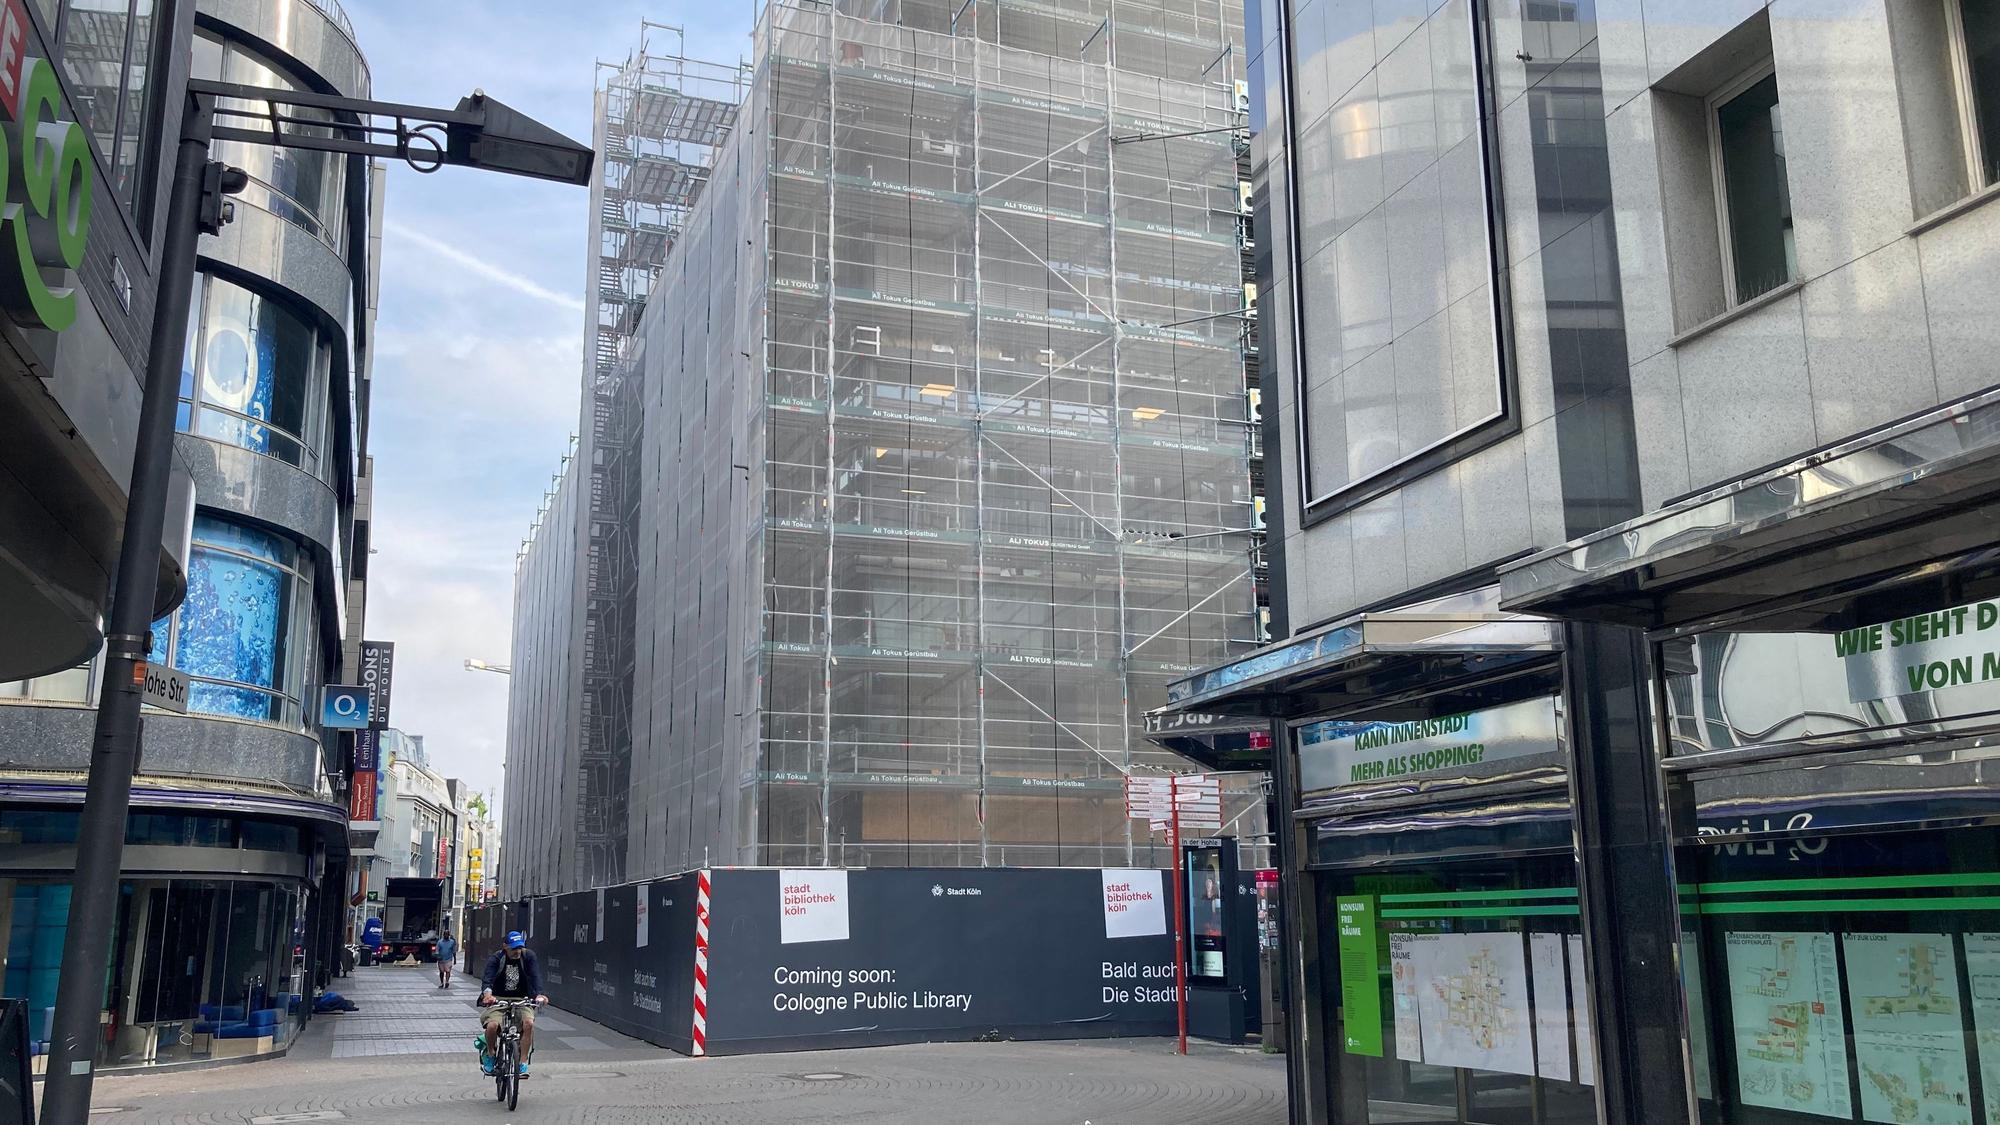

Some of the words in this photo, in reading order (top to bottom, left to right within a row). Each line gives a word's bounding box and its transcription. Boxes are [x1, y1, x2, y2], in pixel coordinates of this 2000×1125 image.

[798, 60, 818, 69] Tokus
[883, 75, 902, 84] Tokus
[1147, 122, 1170, 131] TOKUS
[23, 58, 92, 271] GO
[795, 167, 814, 176] Tokus
[882, 182, 901, 191] Tokus
[1018, 204, 1043, 213] TOKUS
[791, 281, 819, 290] TOKUS
[882, 294, 902, 302] Tokus
[791, 399, 812, 407] Tokus
[883, 411, 902, 420] Tokus
[1027, 426, 1044, 434] Tokus
[791, 520, 813, 529] Tokus
[884, 529, 902, 537] Tokus
[1009, 537, 1021, 545] ALI
[1023, 538, 1050, 547] TOKUS
[1834, 625, 1883, 658] WIE
[1890, 606, 1968, 647] SIEHT
[1025, 656, 1051, 664] TOKUS
[381, 648, 391, 696] MONDE
[1907, 656, 1973, 692] VON
[169, 677, 184, 704] Str.
[1355, 727, 1389, 751] KANN
[1391, 714, 1470, 744] INNENSTADT
[1351, 761, 1384, 781] MEHR
[1387, 755, 1406, 776] ALS
[1409, 743, 1485, 772] SHOPPING?
[882, 775, 901, 783] Tokus
[784, 884, 811, 894] stadt
[947, 887, 966, 896] Stadt
[967, 887, 982, 896] Köln
[1106, 883, 1130, 893] stadt
[784, 893, 836, 905] bibliothek
[1107, 892, 1153, 903] bibliothek
[784, 905, 807, 916] köln
[1108, 903, 1128, 913] köln
[1340, 903, 1365, 912] KONSUM
[1341, 915, 1353, 924] FREI
[1102, 962, 1136, 978] Bald
[774, 966, 843, 988] Coming
[848, 969, 896, 983] soon:
[1103, 986, 1129, 1003] Die
[773, 993, 848, 1014] Cologne
[854, 992, 908, 1009] Public
[913, 991, 972, 1012] Library
